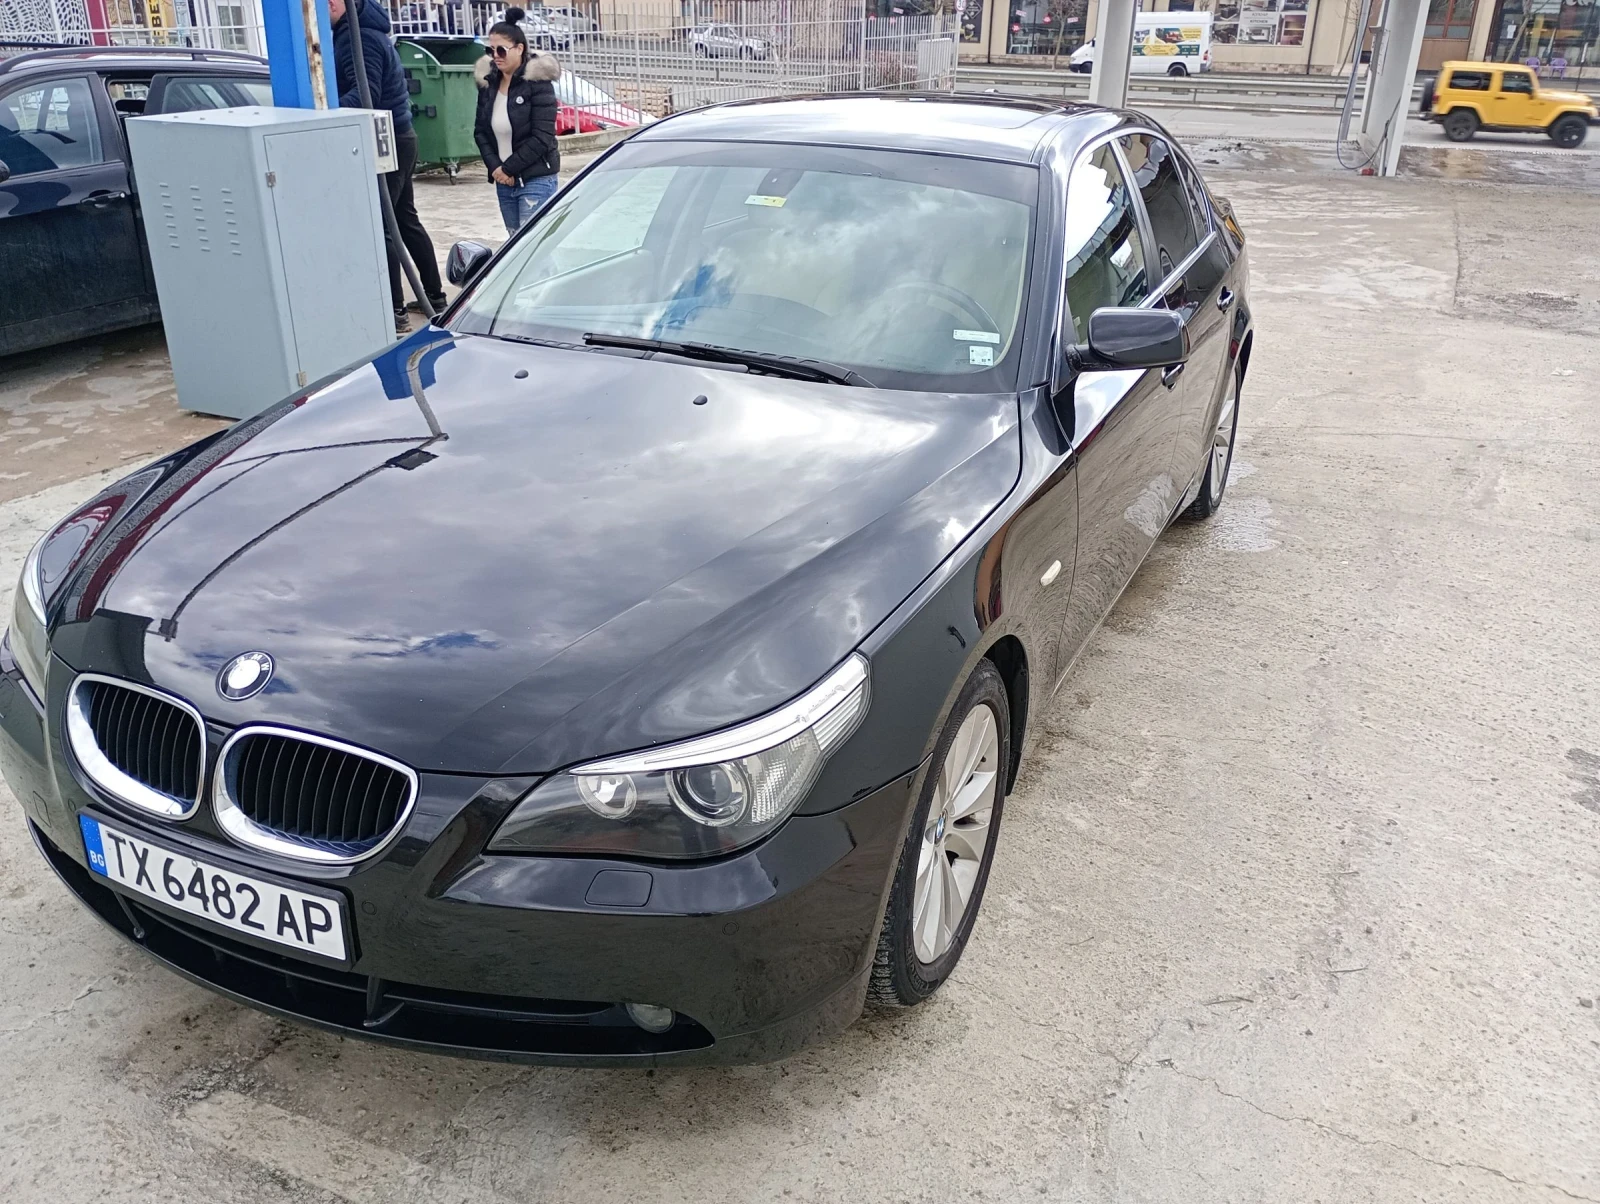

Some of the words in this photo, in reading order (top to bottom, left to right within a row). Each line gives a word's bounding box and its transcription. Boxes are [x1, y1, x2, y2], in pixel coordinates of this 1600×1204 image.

[236, 653, 270, 671] BMW
[89, 850, 105, 868] BG
[107, 832, 156, 893] TX
[162, 857, 265, 931] 6482
[277, 892, 332, 945] AP
